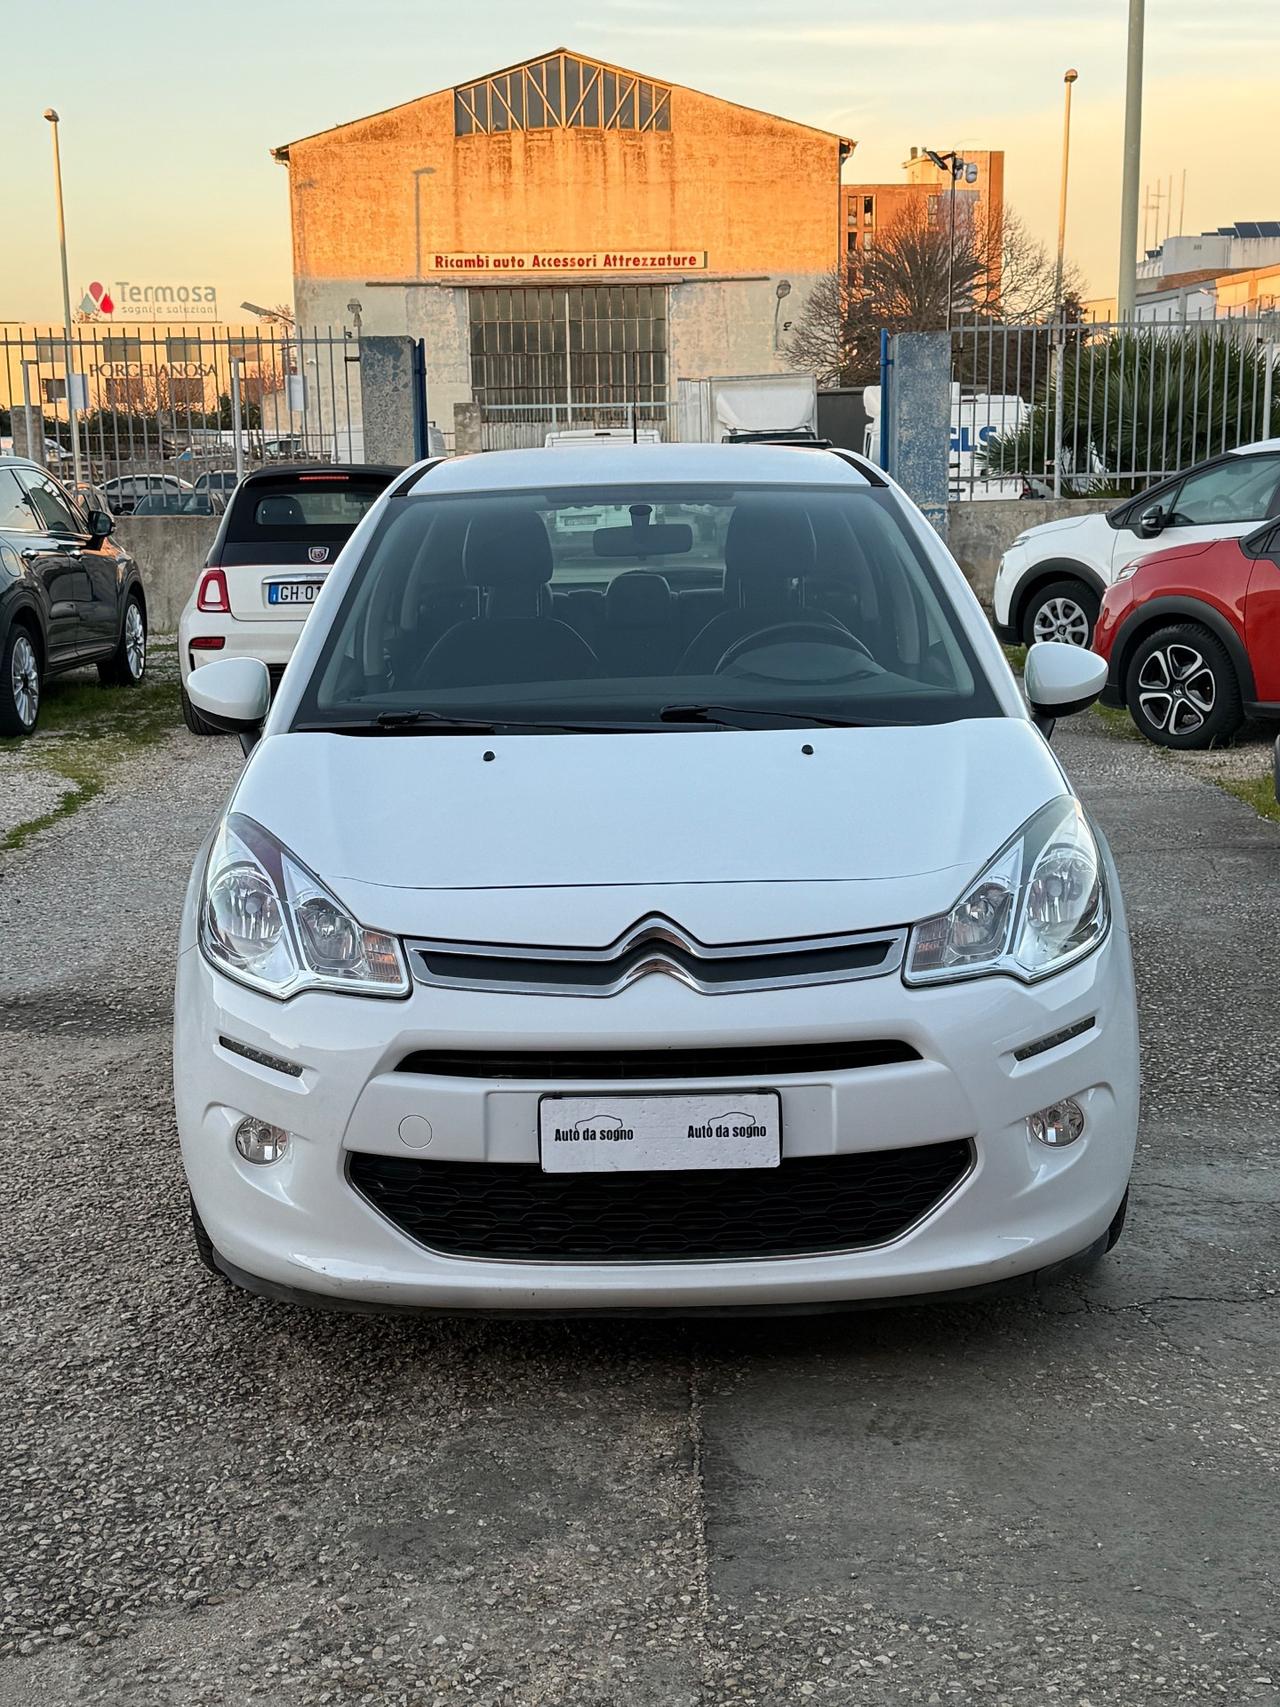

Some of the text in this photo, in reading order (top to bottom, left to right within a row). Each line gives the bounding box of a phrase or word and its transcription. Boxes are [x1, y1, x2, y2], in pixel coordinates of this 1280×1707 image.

[435, 254, 697, 268] Ricambi auto Accessori Attrezzature
[115, 282, 216, 303] Termosa
[89, 363, 218, 378] PORCELANOSA
[280, 586, 299, 601] GH
[554, 1128, 634, 1142] Auto da sogno
[688, 1125, 767, 1139] Auto da sogno
